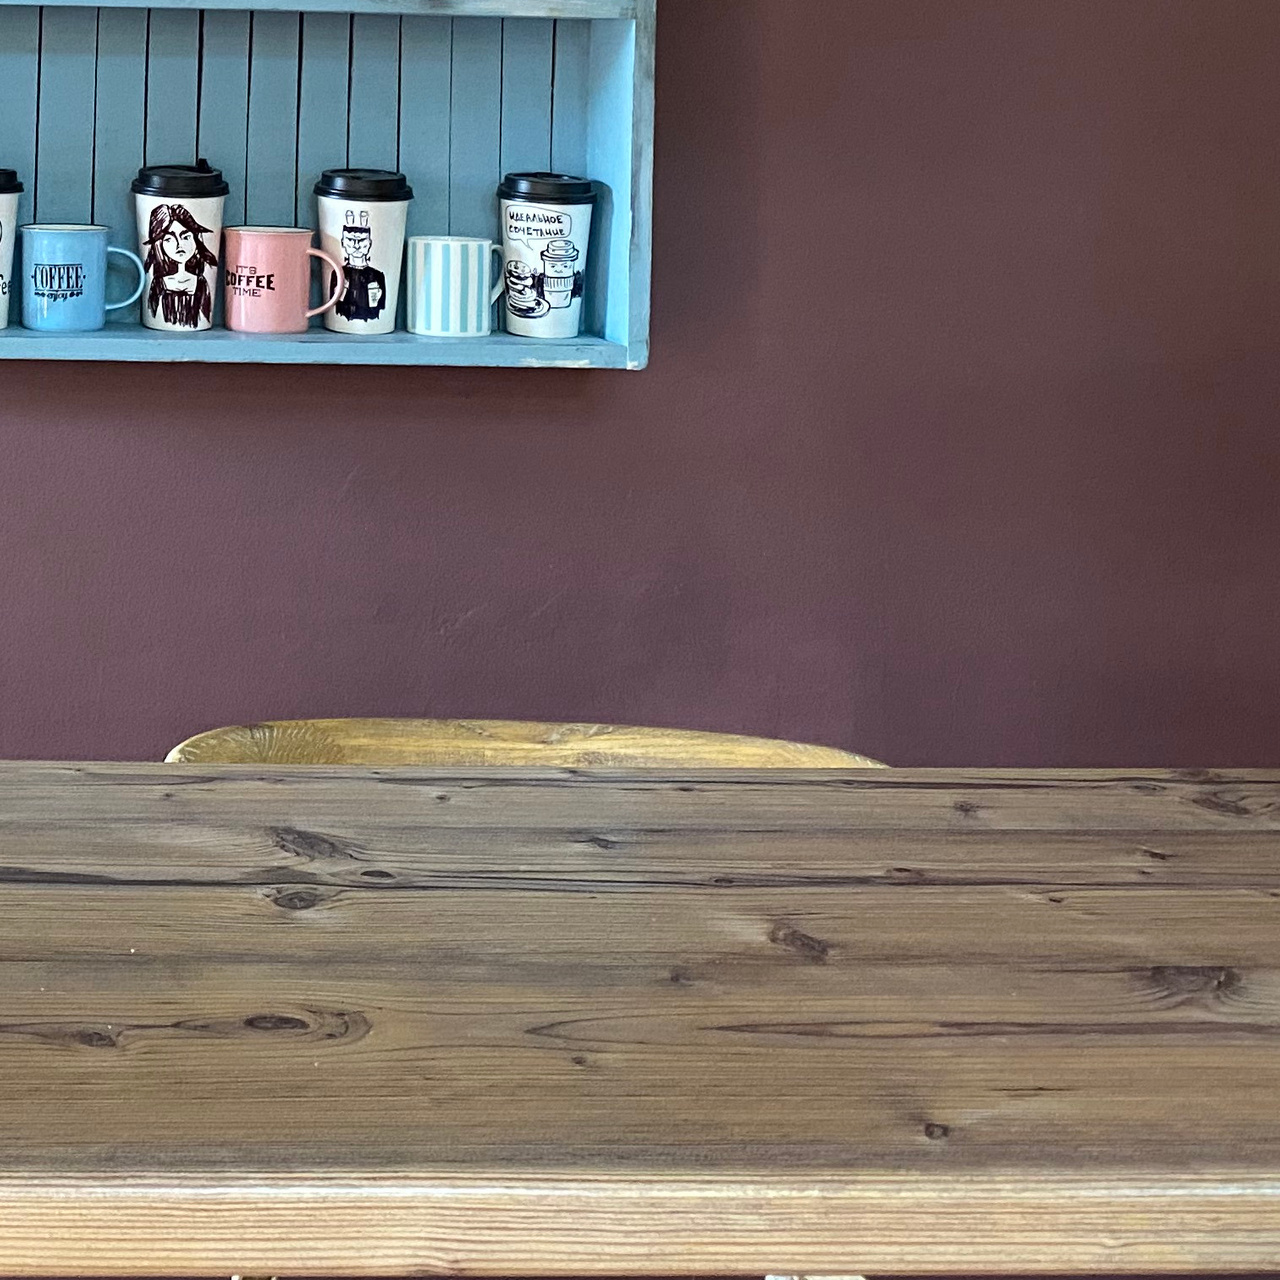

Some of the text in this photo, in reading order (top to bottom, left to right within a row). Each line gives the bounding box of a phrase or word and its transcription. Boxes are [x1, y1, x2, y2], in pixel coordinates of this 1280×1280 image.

[509, 211, 564, 224] ИДЕАЛЬНОЕ
[509, 225, 565, 237] СОЧЕТАНИЕ
[34, 266, 82, 288] COFFEE
[232, 287, 261, 297] TIME
